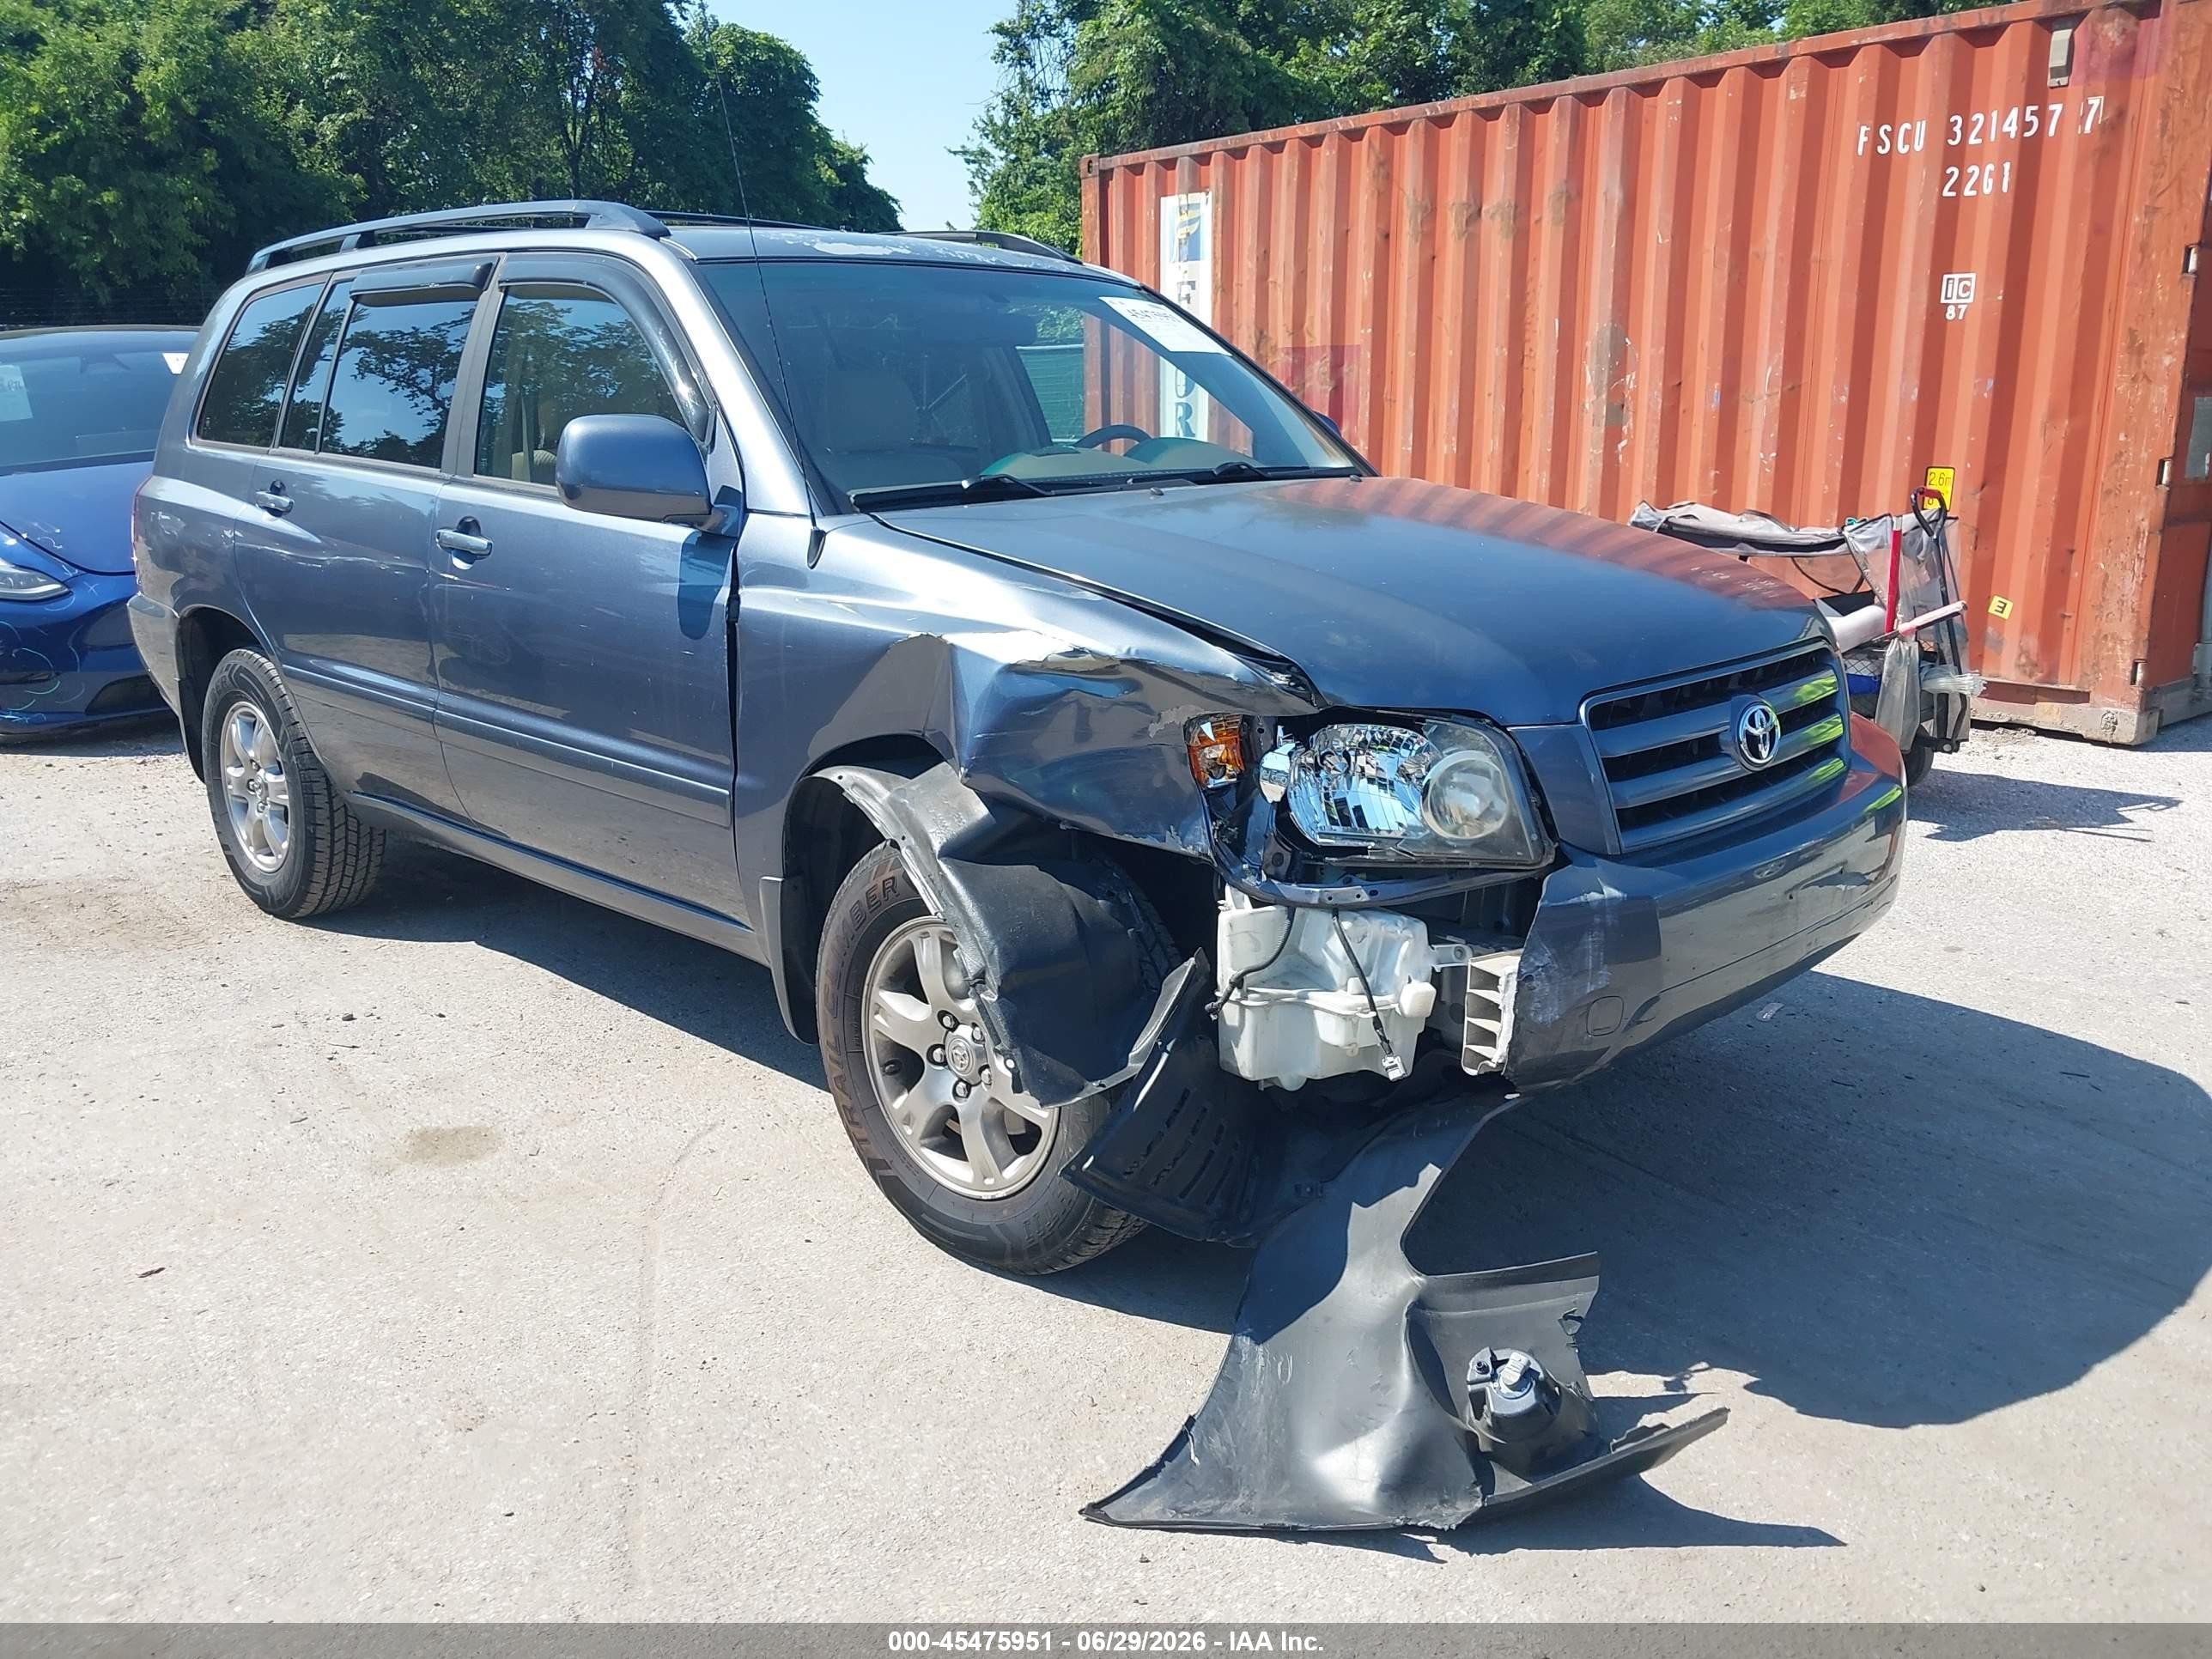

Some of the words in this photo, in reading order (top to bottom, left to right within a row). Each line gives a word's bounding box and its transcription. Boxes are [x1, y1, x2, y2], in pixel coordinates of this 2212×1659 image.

[1857, 119, 1926, 156] FSCU
[1948, 103, 2063, 146] 321457
[2083, 96, 2103, 134] 7
[1942, 161, 2011, 197] 22G1
[1945, 304, 1968, 320] 87
